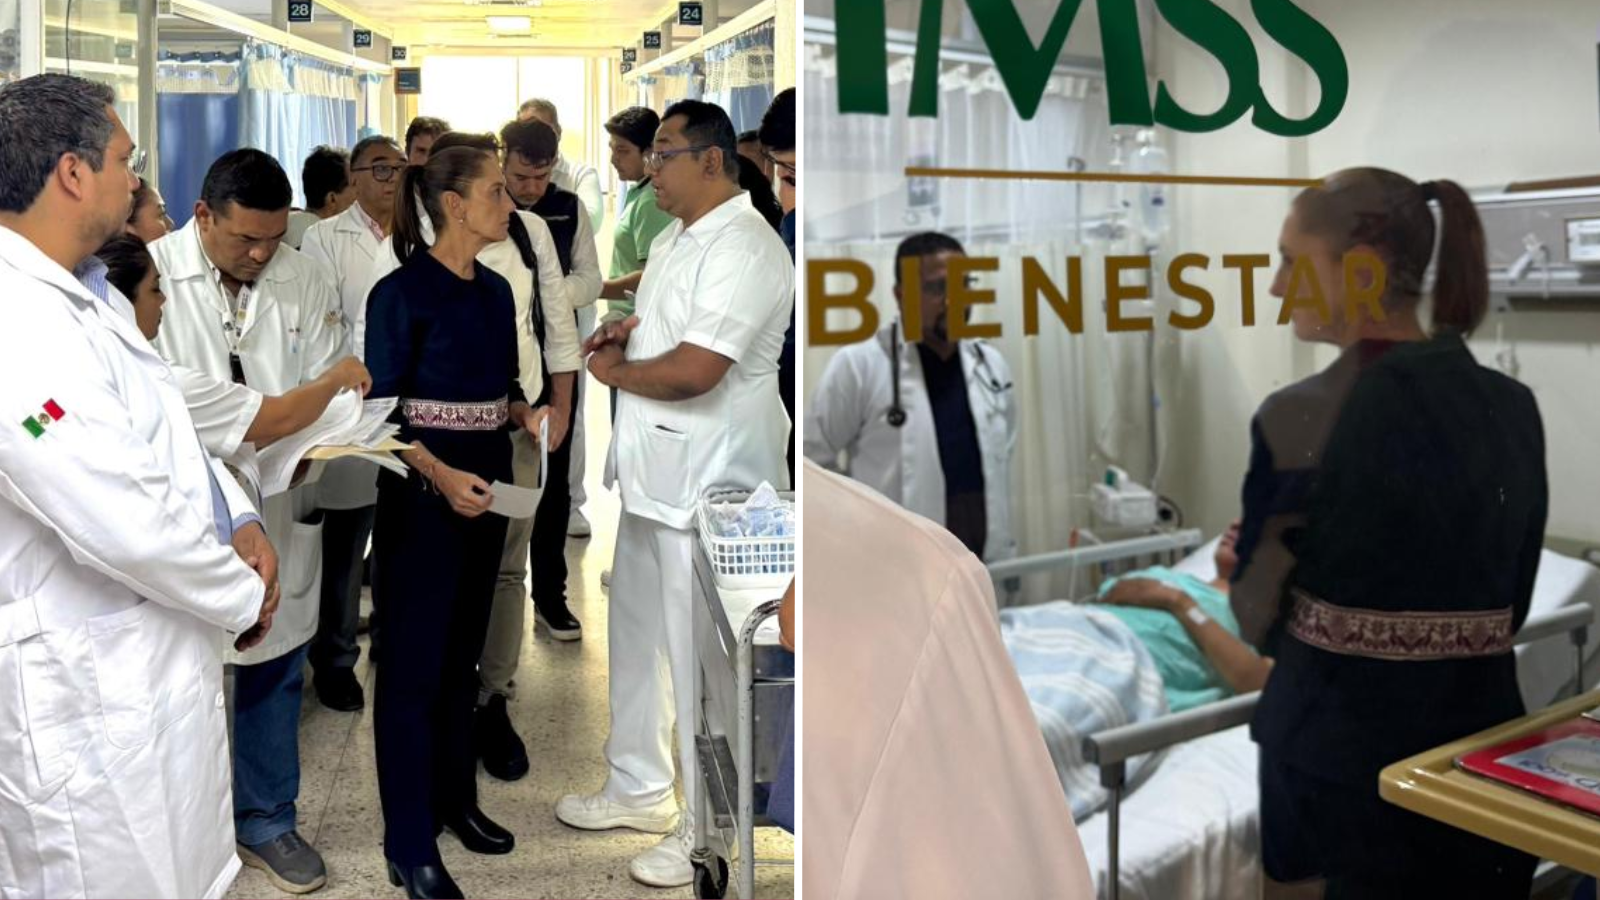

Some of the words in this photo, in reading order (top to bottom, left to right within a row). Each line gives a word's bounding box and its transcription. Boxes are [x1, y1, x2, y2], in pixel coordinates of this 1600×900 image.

[291, 4, 309, 16] 28
[682, 7, 700, 19] 24
[355, 34, 370, 44] 29
[646, 36, 659, 45] 25
[836, 0, 1349, 136] IMSS
[806, 252, 1388, 346] BIENESTAR
